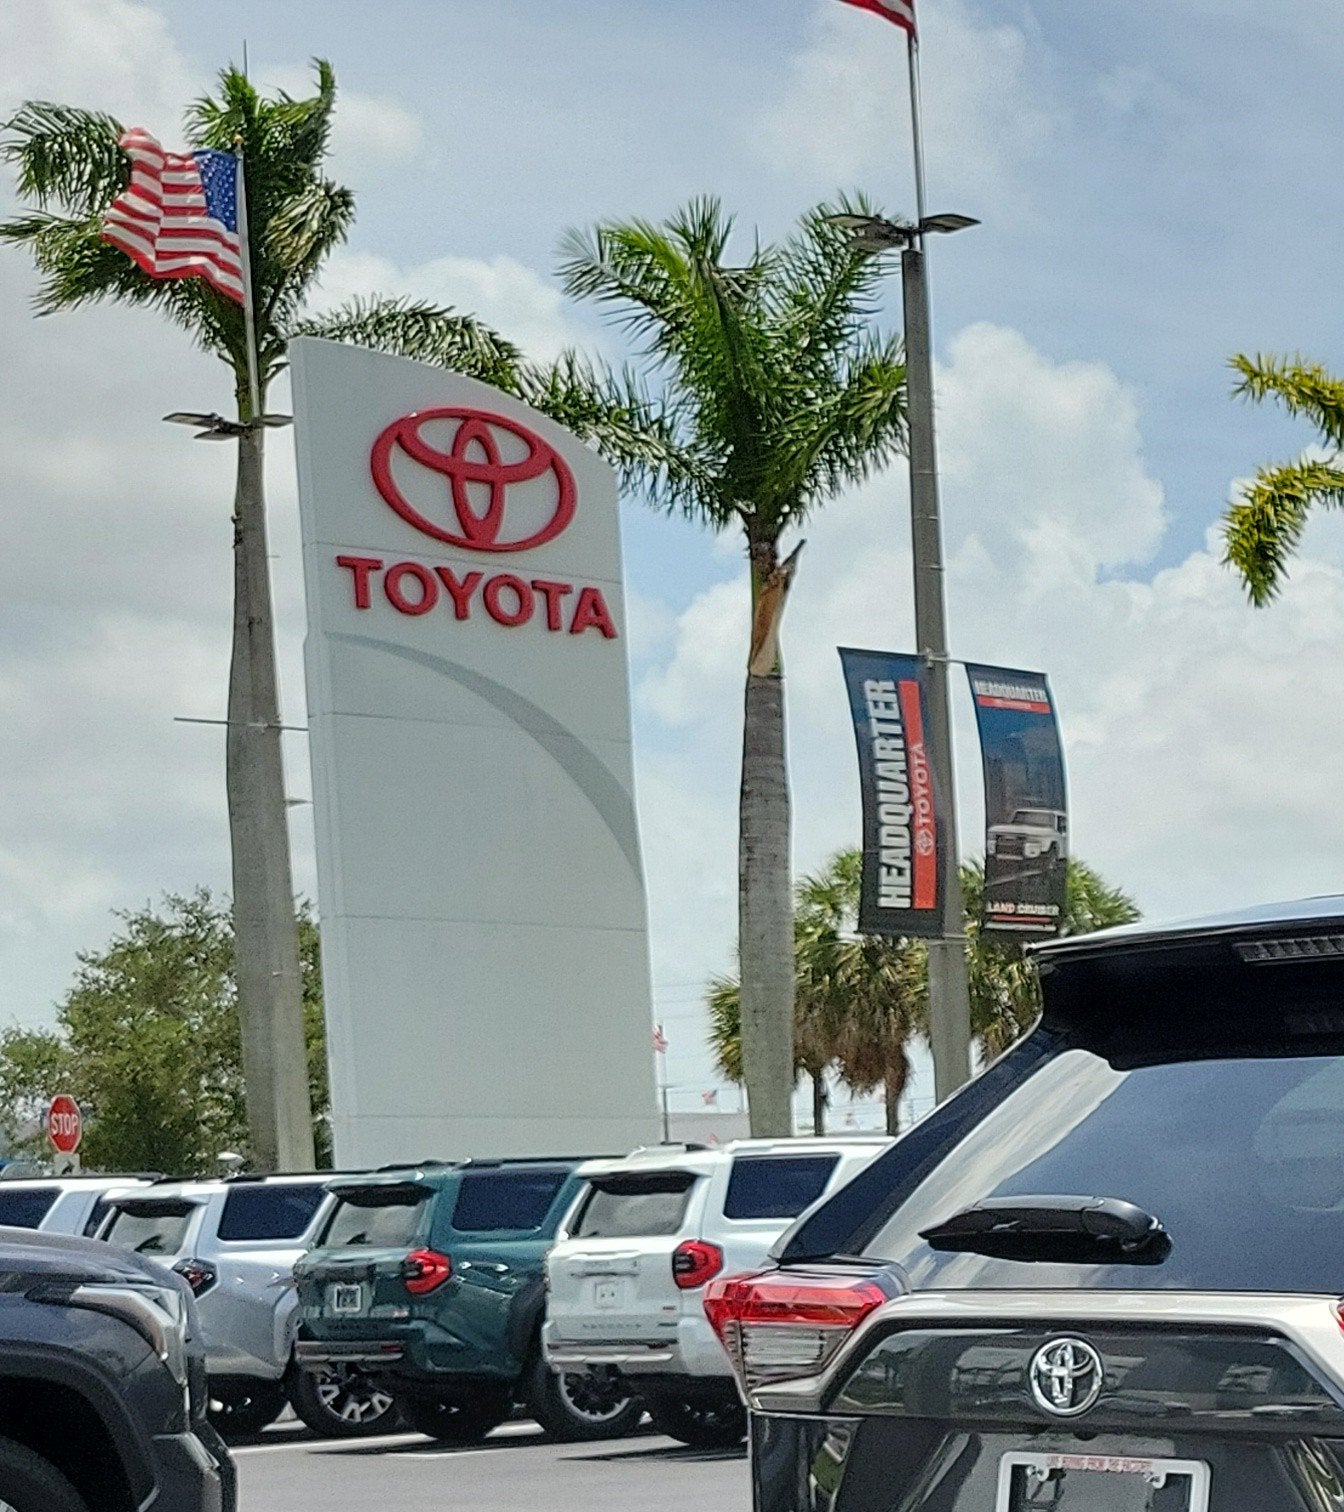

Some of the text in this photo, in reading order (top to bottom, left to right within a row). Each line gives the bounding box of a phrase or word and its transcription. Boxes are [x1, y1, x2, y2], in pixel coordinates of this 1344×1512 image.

[336, 555, 618, 639] TOYOTA
[864, 679, 913, 909] HEADQUARTER
[912, 742, 932, 825] TOYOTA
[986, 901, 1015, 914] LAND
[51, 1112, 79, 1136] STOP
